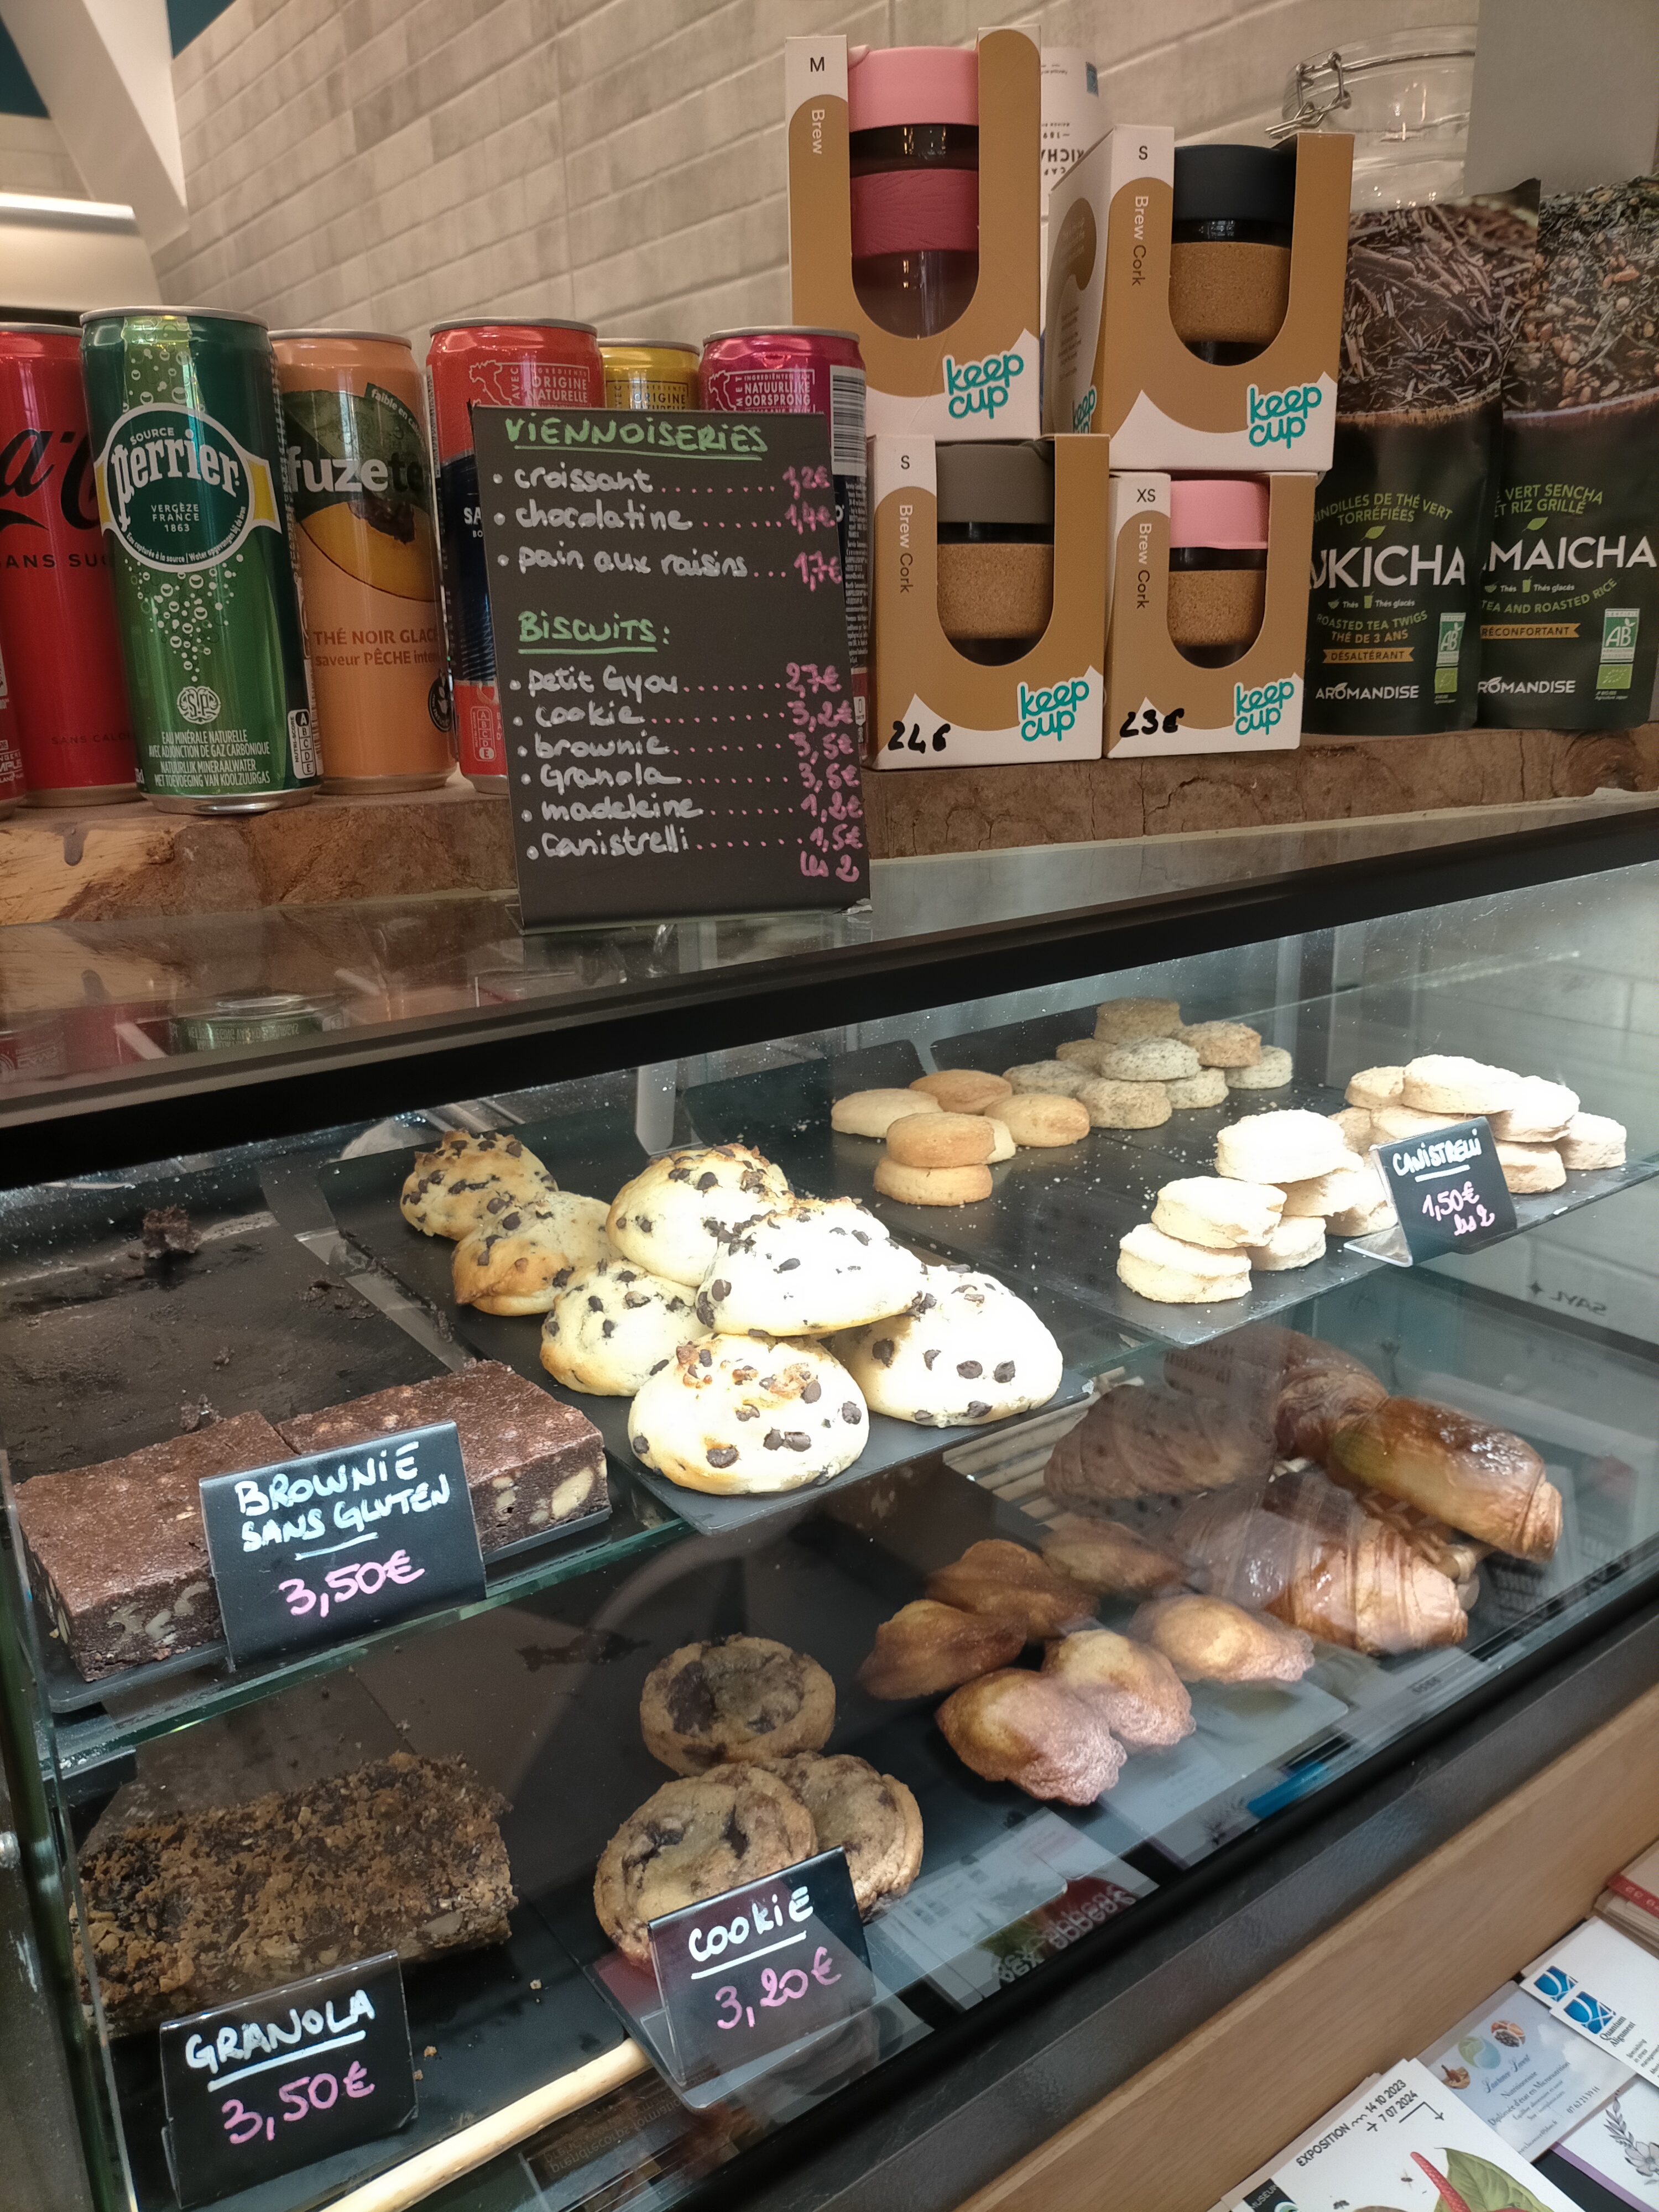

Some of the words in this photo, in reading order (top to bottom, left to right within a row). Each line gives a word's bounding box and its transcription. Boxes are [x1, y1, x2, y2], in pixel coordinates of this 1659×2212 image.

[810, 57, 826, 72] M
[811, 109, 826, 155] Brew
[1138, 145, 1149, 160] S
[1133, 195, 1149, 241] Brew
[1131, 244, 1146, 286] Cork
[510, 367, 520, 400] AVEC
[744, 380, 811, 394] NATUURLIJKE
[946, 353, 1024, 395] keep
[371, 388, 397, 411] faible
[398, 407, 408, 420] en
[526, 388, 587, 403] NATURELLE
[744, 394, 811, 407] OORSPRONG
[948, 386, 1009, 419] cup
[1250, 386, 1322, 424] keep
[129, 427, 175, 445] SOURCE
[1249, 416, 1306, 449] cup
[900, 456, 910, 470] S
[514, 462, 654, 494] croissant
[150, 502, 200, 514] VERGÈZE
[1136, 489, 1156, 503] XS
[1374, 493, 1392, 505] DE
[1396, 492, 1421, 509] THÉ
[1422, 499, 1453, 520] VERT
[1505, 484, 1541, 500] VERT
[1544, 483, 1603, 505] SENCHA
[1511, 499, 1532, 514] RIZ
[1537, 498, 1587, 515] GRILLÉ
[152, 513, 200, 522] FRANCE
[164, 523, 190, 533] 1863
[515, 500, 693, 531] chocolatine
[899, 505, 913, 549] Brew
[1337, 505, 1415, 525] TORRÉFIÉES
[189, 549, 207, 562] Water
[1139, 523, 1152, 565] Brew
[1488, 535, 1658, 572] MAICHA
[6, 553, 56, 569] ANS
[166, 554, 185, 564] source
[518, 540, 584, 574] pain
[594, 552, 651, 573] aux
[660, 549, 749, 578] raisins
[899, 552, 914, 593] Cork
[1136, 569, 1151, 609] Cork
[1481, 599, 1501, 612] TEA
[1504, 602, 1531, 614] AND
[1534, 593, 1590, 613] ROASTED
[1592, 578, 1618, 599] RICE
[1317, 613, 1363, 631] ROASTED
[1366, 619, 1389, 630] TEA
[1391, 609, 1428, 628] TWIGS
[1481, 626, 1570, 637] RÉCONFORTANT
[313, 627, 347, 646] THÉ
[352, 630, 397, 645] NOIR
[1331, 629, 1352, 643] THÉ
[1355, 633, 1370, 644] DE
[1374, 633, 1381, 644] 3
[1384, 628, 1408, 643] ANS
[1440, 630, 1458, 651] AB
[1605, 625, 1632, 647] AB
[315, 655, 361, 667] saveur
[364, 647, 412, 665] PÊCHE
[1331, 650, 1405, 661] DÉSALTÉRANT
[528, 666, 594, 697] petit
[1478, 679, 1576, 694] ROMANDISE
[1020, 681, 1089, 720] keep
[1235, 681, 1295, 716] keep
[535, 701, 646, 726] cookie
[1021, 710, 1076, 741] cup
[1235, 707, 1281, 735] cup
[148, 745, 161, 758] AVEC
[161, 745, 200, 758] ADJONCTION
[200, 744, 210, 758] DE
[211, 744, 226, 757] GAZ
[226, 741, 270, 757] CARBONIQUE
[161, 731, 174, 744] EAU
[174, 729, 208, 744] MINÉRALE
[208, 728, 248, 743] NATURELLE
[534, 729, 671, 758] brownie
[155, 774, 164, 787] MET
[164, 774, 205, 787] TOEVOEGING
[205, 773, 220, 787] VAN
[221, 770, 270, 786] KOOLZUURGAS
[160, 760, 197, 774] NATUURLIJK
[198, 758, 257, 773] MINERAALWATER
[541, 792, 705, 822] madeleine
[1422, 1181, 1479, 1221] 1,50€
[234, 1441, 419, 1516] BROWNIE
[242, 1508, 326, 1552] SANS
[333, 1473, 451, 1532] GLUTEN
[278, 1549, 425, 1618] 3,50€
[688, 1886, 813, 1962] COOKIE
[715, 1946, 842, 2030] 3,20€
[186, 1989, 375, 2074] GRANOLA
[1599, 2016, 1627, 2041] Quantum
[1610, 2021, 1636, 2047] Alignment
[1500, 2071, 1538, 2099] Nutritionniste
[1528, 2087, 1537, 2096] en
[1533, 2060, 1571, 2090] Micronutrition
[222, 2060, 375, 2145] 3,50€
[1378, 2112, 1387, 2122] 7
[1386, 2105, 1398, 2118] 07
[1395, 2089, 1418, 2110] 2024
[1296, 2122, 1351, 2167] EXPOSITION
[1365, 2101, 1378, 2114] 14
[1374, 2094, 1387, 2106] 10
[1383, 2079, 1406, 2100] 2023
